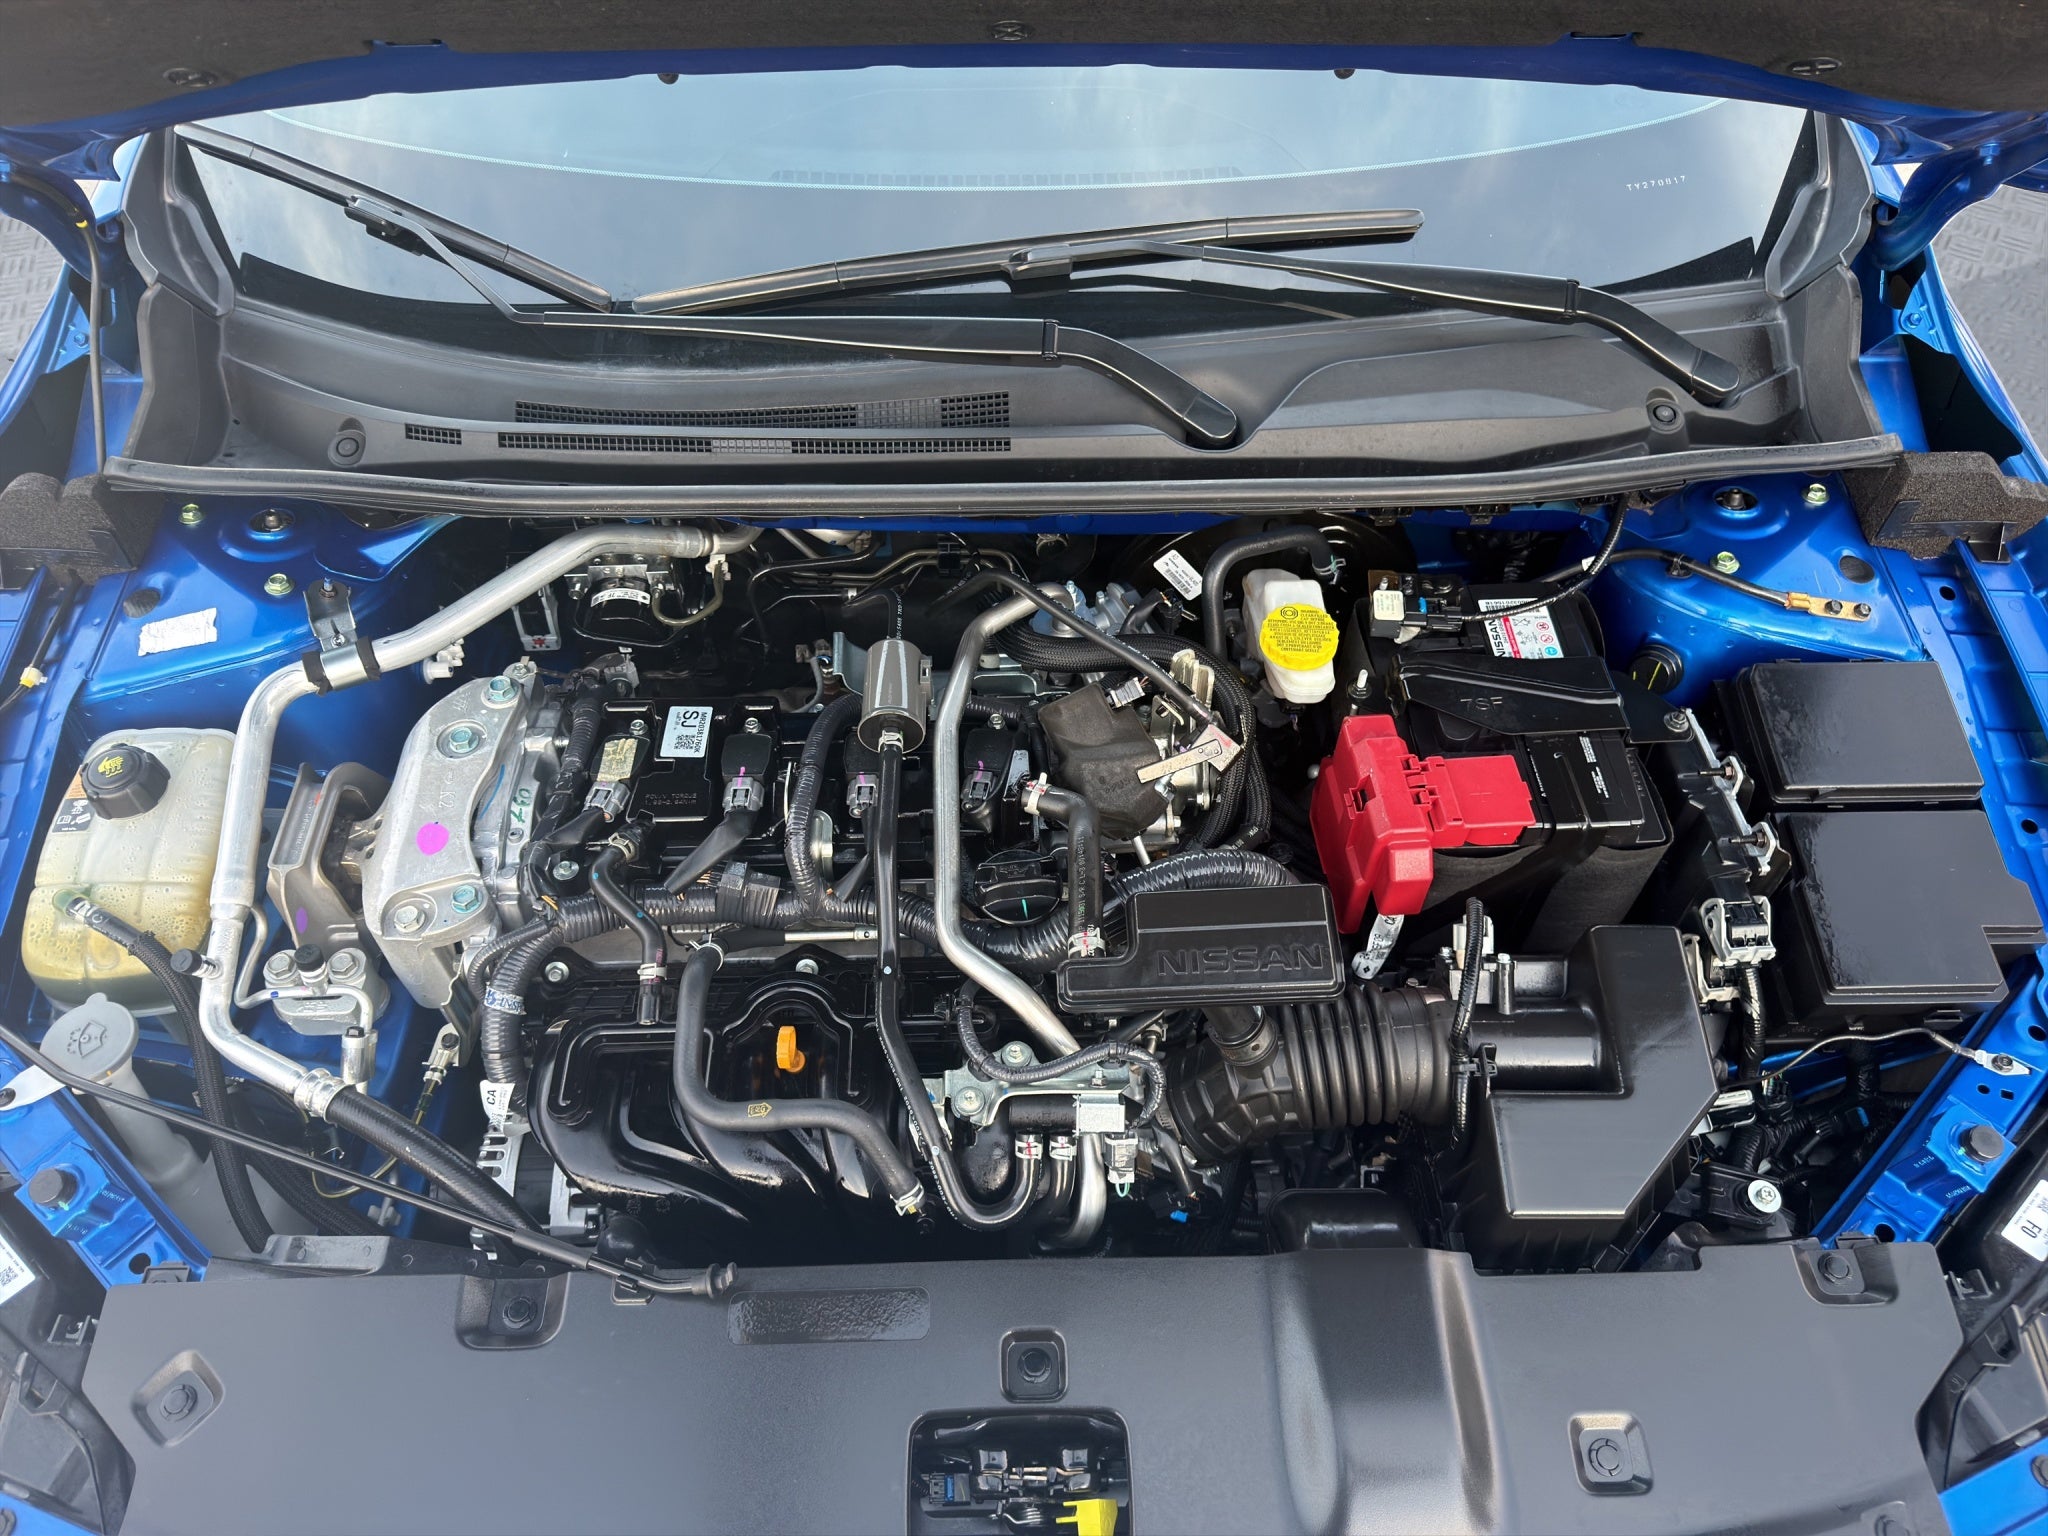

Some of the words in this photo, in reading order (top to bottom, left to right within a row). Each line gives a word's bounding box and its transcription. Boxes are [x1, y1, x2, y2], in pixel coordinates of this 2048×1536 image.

[681, 710, 700, 728] SJ
[1157, 944, 1324, 976] NISSAN
[487, 1090, 496, 1105] CA
